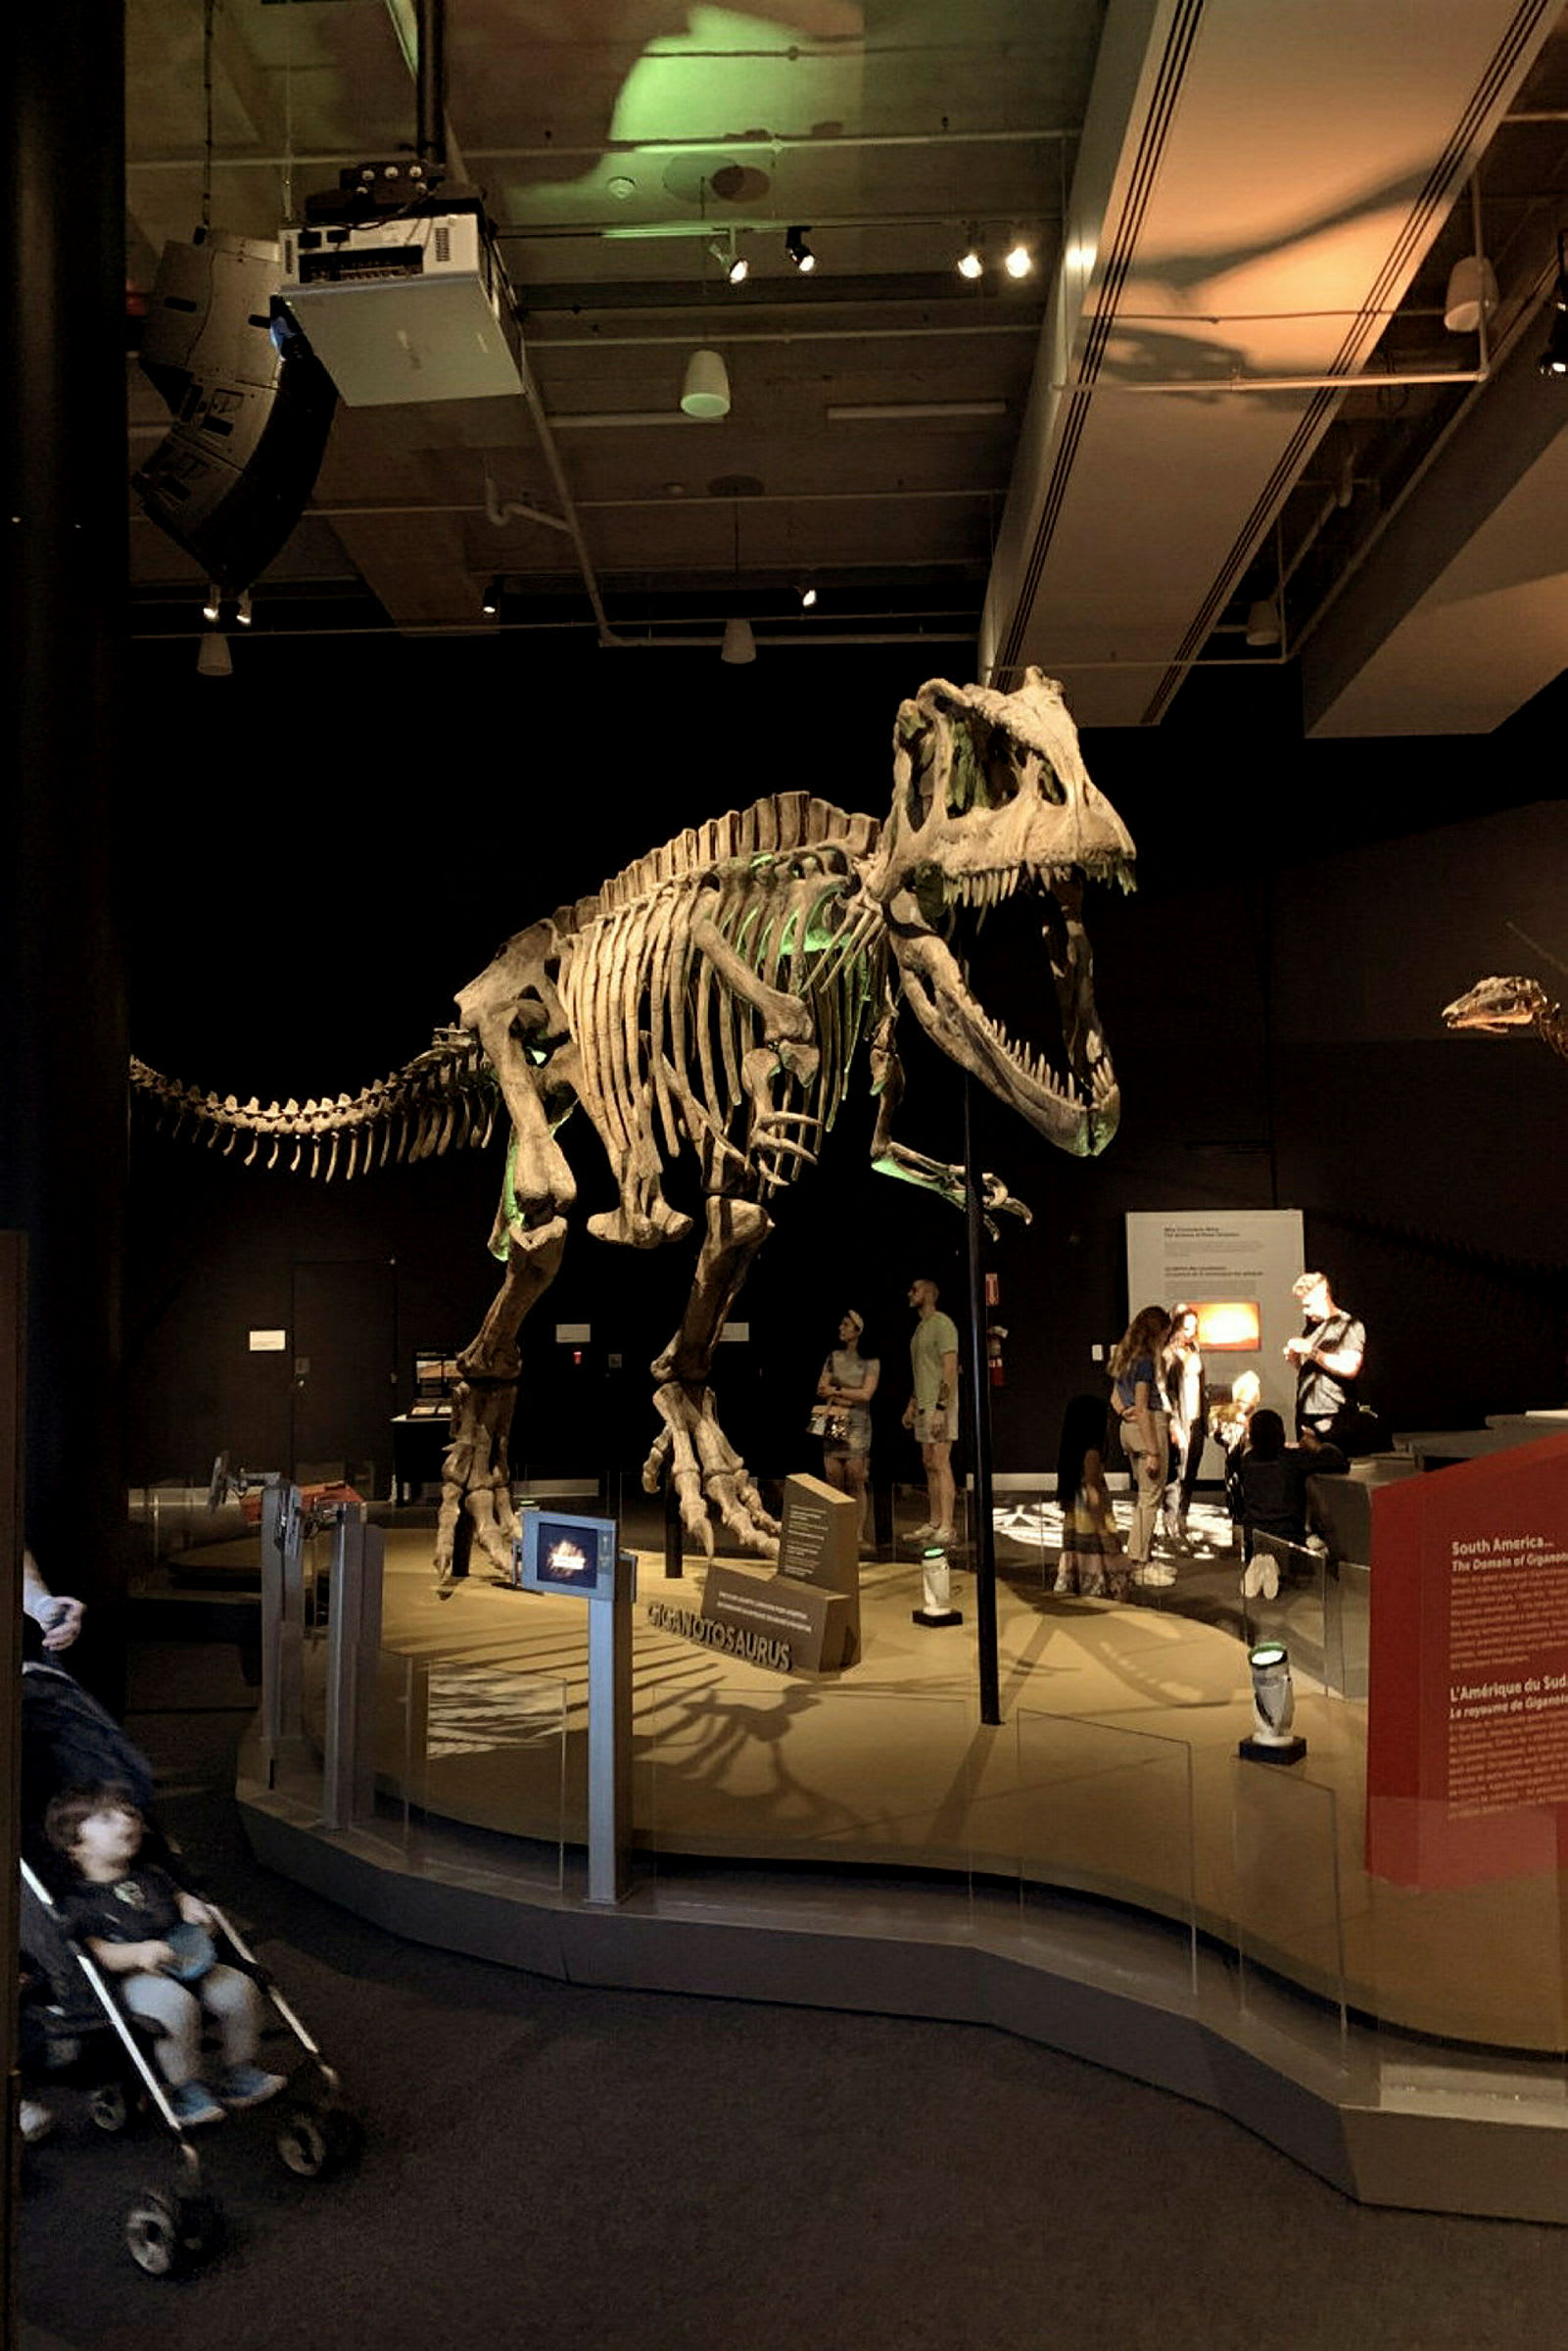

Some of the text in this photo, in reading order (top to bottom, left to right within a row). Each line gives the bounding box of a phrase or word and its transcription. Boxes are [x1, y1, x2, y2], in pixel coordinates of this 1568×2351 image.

[1451, 1539, 1491, 1556] South
[1452, 1559, 1470, 1571] The
[1473, 1557, 1511, 1570] Domain
[1514, 1555, 1525, 1566] of
[648, 1603, 792, 1670] GIGANOTOSAURUS
[1450, 1682, 1522, 1703] L'Amérique
[1524, 1677, 1541, 1693] du
[1450, 1707, 1461, 1719] Le
[1464, 1703, 1508, 1719] royaume
[1510, 1700, 1523, 1712] de
